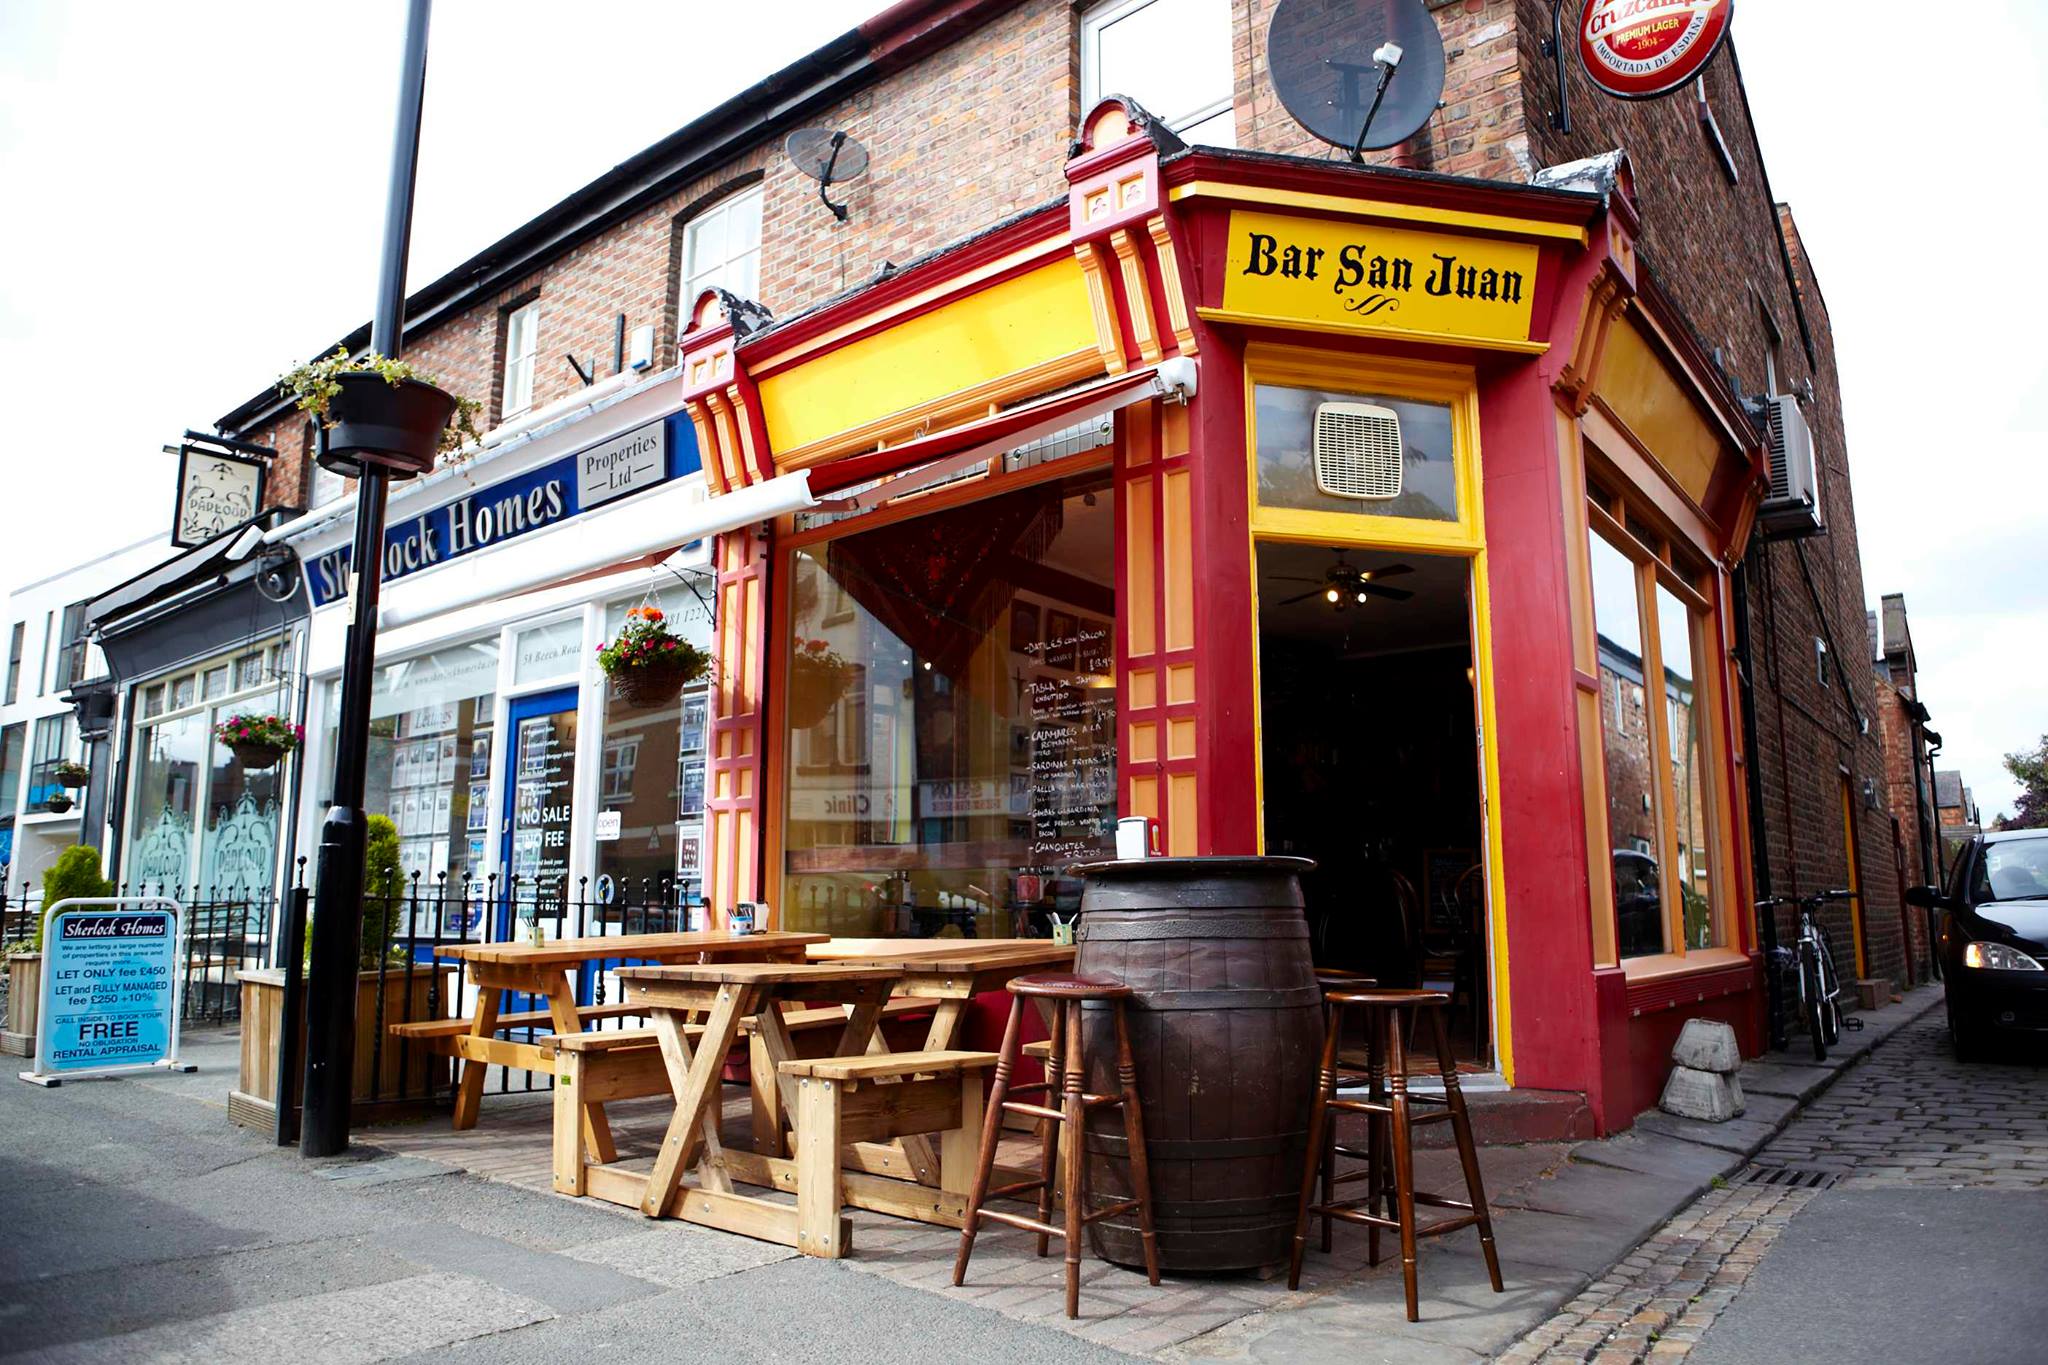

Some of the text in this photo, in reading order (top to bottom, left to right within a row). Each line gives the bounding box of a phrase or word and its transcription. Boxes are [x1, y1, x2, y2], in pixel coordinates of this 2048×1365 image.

[1615, 18, 1680, 46] PREMIUM LAGER
[1596, 42, 1652, 73] IMPORTADA
[1654, 54, 1671, 69] DE
[1243, 232, 1524, 305] Bar San Juan
[585, 433, 658, 476] Properties
[608, 468, 633, 491] Ltd
[319, 478, 563, 603] Shock Homes
[522, 804, 571, 824] NO SALE
[523, 829, 566, 849] NO FEE
[64, 917, 165, 937] Sherlock Homes
[71, 952, 109, 960] properties
[88, 943, 112, 952] letting
[56, 966, 166, 980] LET ONLY fee £450
[55, 980, 168, 996] LET and FULLY MANAGED
[68, 996, 88, 1006] fee
[91, 994, 118, 1005] £250
[55, 1017, 77, 1025] CALL
[78, 1015, 104, 1023] INSIDE
[106, 1014, 117, 1022] TO
[117, 1013, 139, 1021] BOOK
[79, 1020, 139, 1041] FREE
[53, 1043, 161, 1059] RENTAL APPRAISAL
[79, 1038, 139, 1048] NO OBLIGATION
